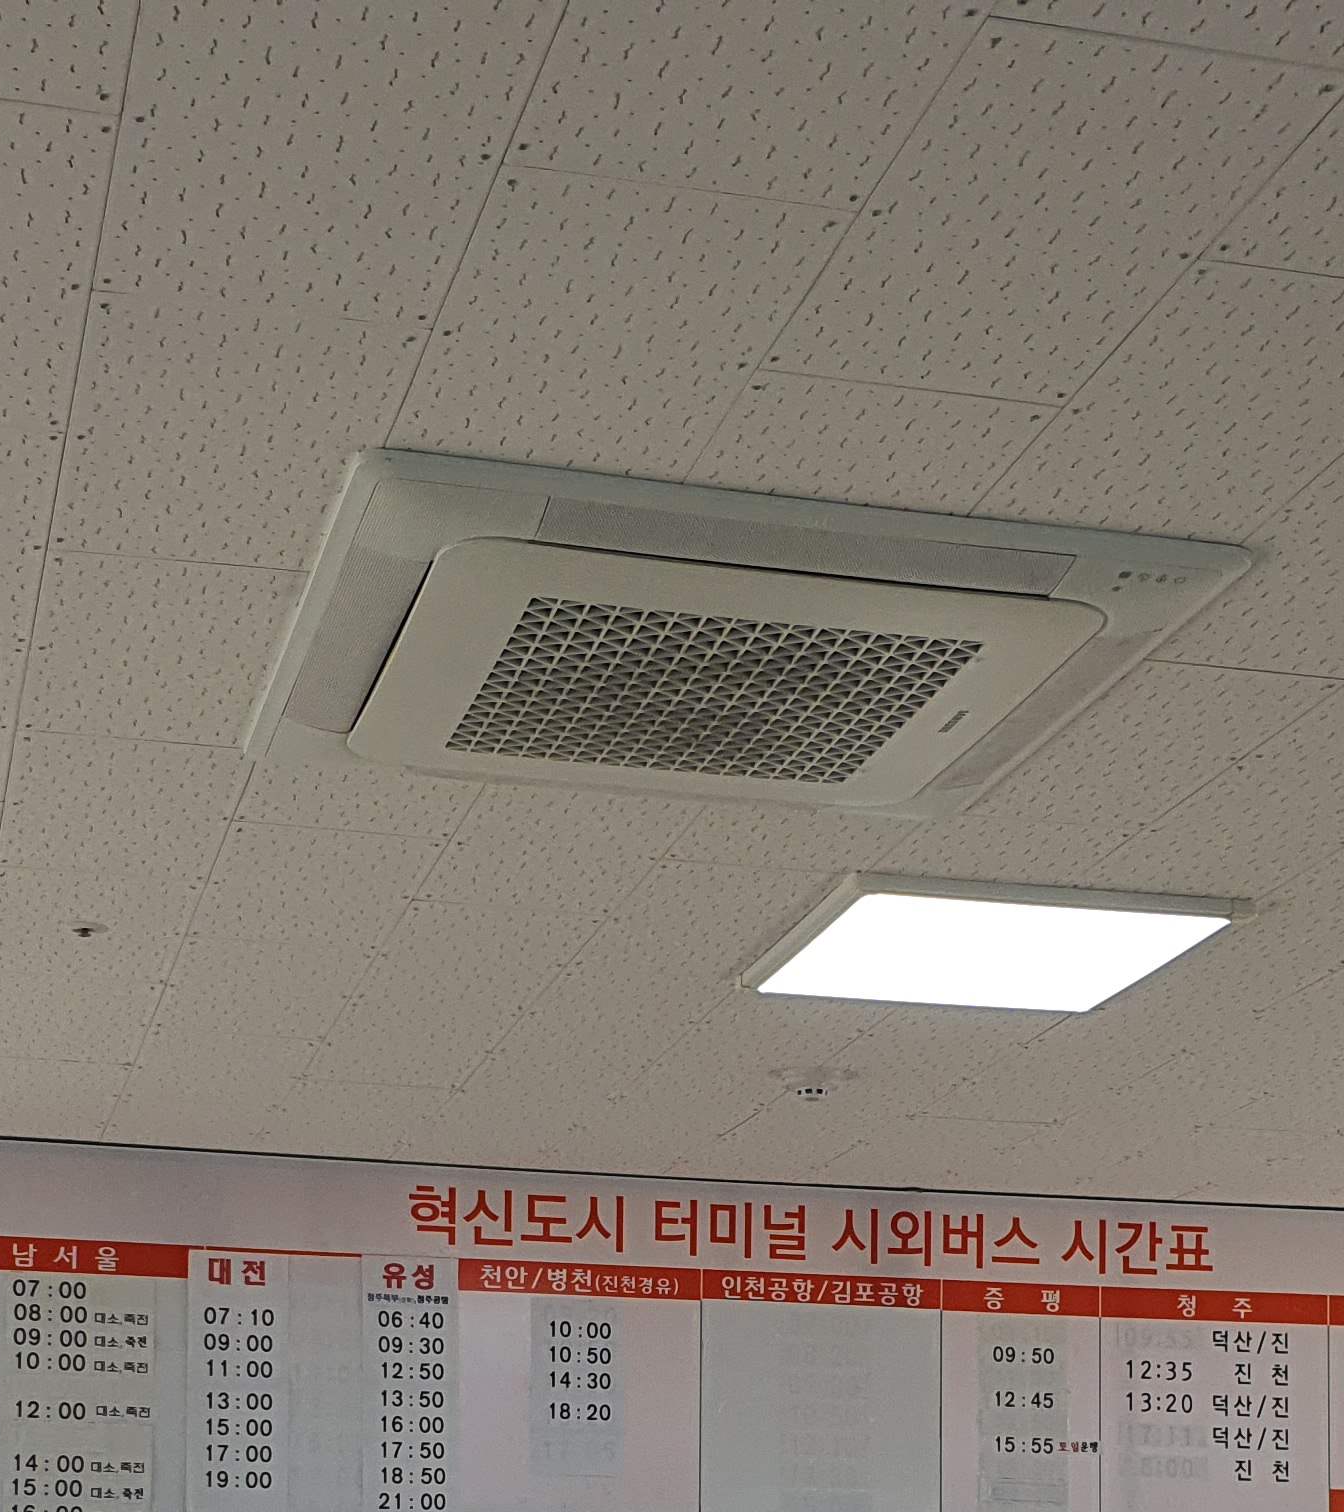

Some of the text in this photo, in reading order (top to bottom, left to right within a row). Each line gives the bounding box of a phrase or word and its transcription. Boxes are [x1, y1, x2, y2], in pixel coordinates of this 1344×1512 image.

[409, 1186, 1213, 1275] 혁신도시 터미널 시외버스 시간표
[209, 1258, 265, 1286] 대전
[383, 1263, 434, 1290] 유성
[13, 1279, 86, 1299] 07:00
[14, 1304, 87, 1323] 08:00
[204, 1307, 274, 1326] 07:10
[379, 1311, 443, 1329] 06:40
[14, 1328, 86, 1347] 09:00
[551, 1321, 611, 1339] 10:00
[204, 1334, 272, 1352] 09:00
[379, 1336, 443, 1354] 09:30
[16, 1352, 85, 1371] 10:00
[550, 1346, 611, 1364] 10:50
[993, 1346, 1054, 1364] 09:50
[207, 1360, 272, 1378] 11:00
[382, 1362, 443, 1380] 12:50
[1127, 1360, 1191, 1381] 12:35
[550, 1372, 610, 1389] 14:30
[207, 1392, 272, 1410] 13:00
[382, 1390, 443, 1408] 13:50
[996, 1391, 1053, 1408] 12:45
[1127, 1392, 1192, 1413] 13:20
[16, 1401, 85, 1420] 12:00
[550, 1403, 610, 1420] 18:20
[207, 1419, 272, 1436] 15:00
[382, 1416, 443, 1433] 16:00
[207, 1445, 271, 1462] 17:00
[382, 1442, 444, 1459] 17:50
[996, 1437, 1053, 1454] 15:55
[15, 1454, 84, 1473] 14:00
[206, 1471, 271, 1488] 19:00
[382, 1468, 445, 1484] 18:50
[13, 1479, 82, 1497] 15:00
[379, 1493, 445, 1510] 21:00
